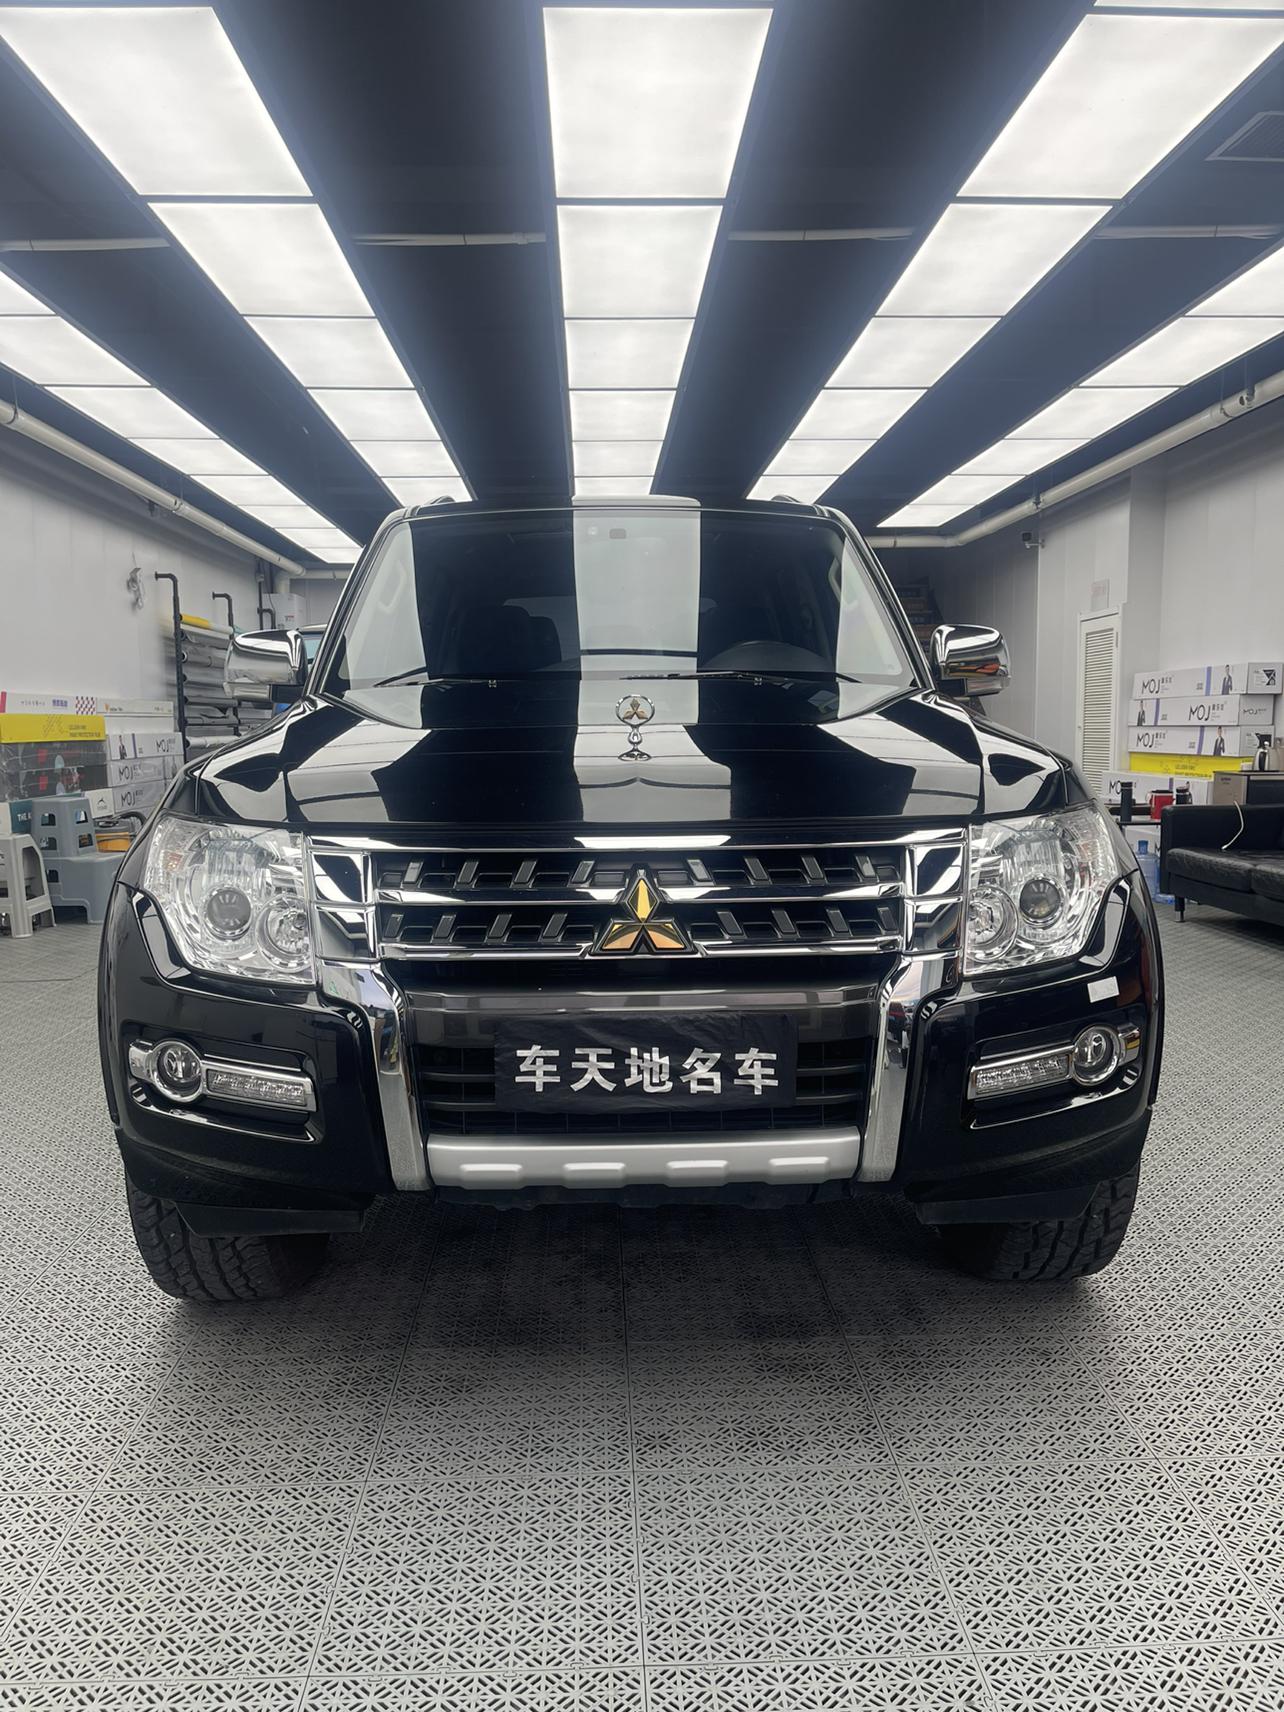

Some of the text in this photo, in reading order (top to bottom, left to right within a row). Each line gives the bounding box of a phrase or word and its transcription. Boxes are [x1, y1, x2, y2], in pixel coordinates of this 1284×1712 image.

[1141, 678, 1161, 695] MOJ
[1188, 704, 1211, 721] MOJ
[1136, 732, 1155, 749] MOJ
[119, 766, 134, 780] MOJ
[121, 791, 136, 807] MOJ
[515, 1045, 779, 1095] 车天地名车
